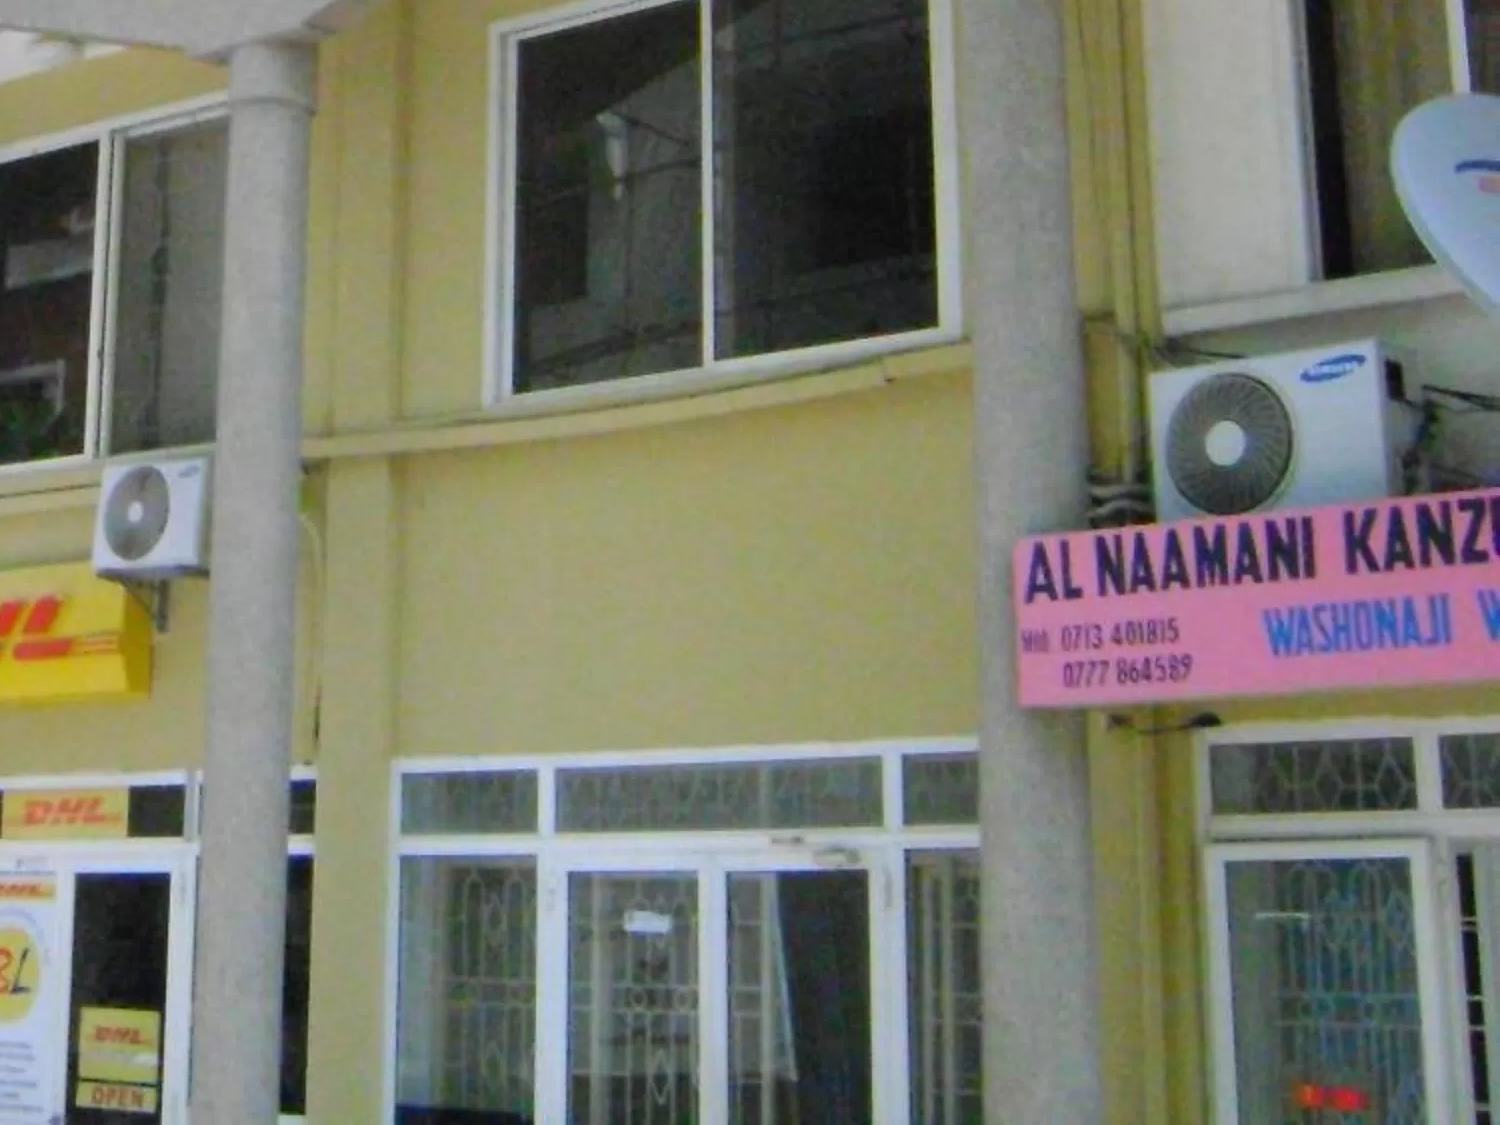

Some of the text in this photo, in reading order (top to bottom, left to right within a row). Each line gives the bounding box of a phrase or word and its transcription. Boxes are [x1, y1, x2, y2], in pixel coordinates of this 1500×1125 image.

[1023, 539, 1084, 605] AL
[1094, 515, 1317, 597] NAAMANI
[1060, 623, 1103, 652] 0713
[1262, 592, 1452, 658] WASHONAJI
[1062, 659, 1110, 688] 0777
[23, 796, 106, 828] DHL
[91, 1084, 145, 1107] OPEN
